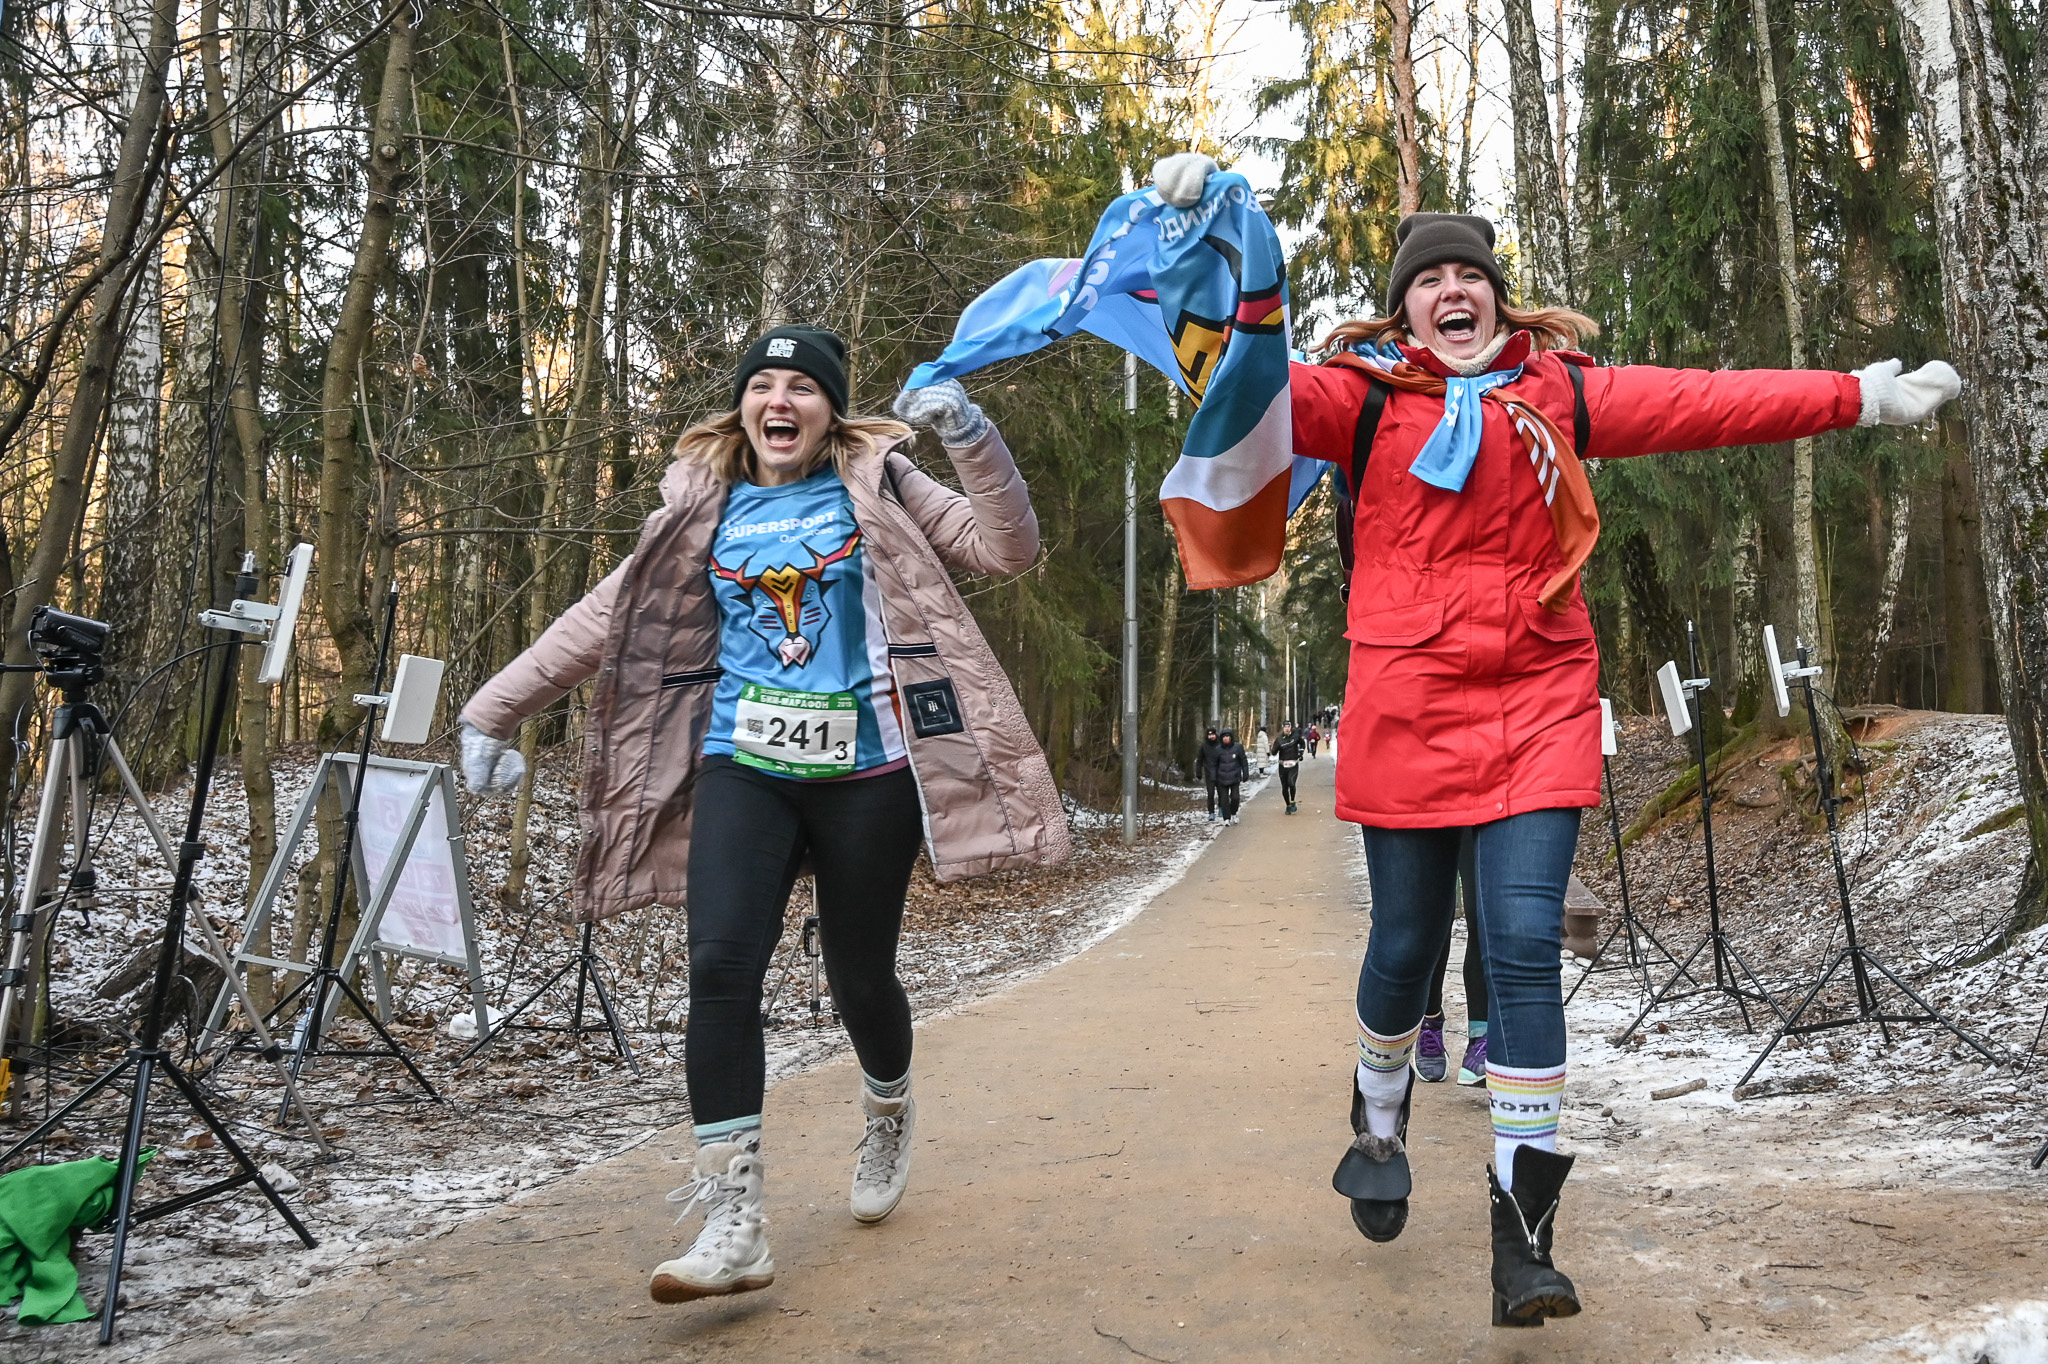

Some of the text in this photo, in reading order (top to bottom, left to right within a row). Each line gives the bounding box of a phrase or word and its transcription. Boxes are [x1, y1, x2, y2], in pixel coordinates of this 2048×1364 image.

[725, 511, 836, 541] SUPERSPORT
[767, 717, 829, 750] 241
[834, 740, 848, 761] 3
